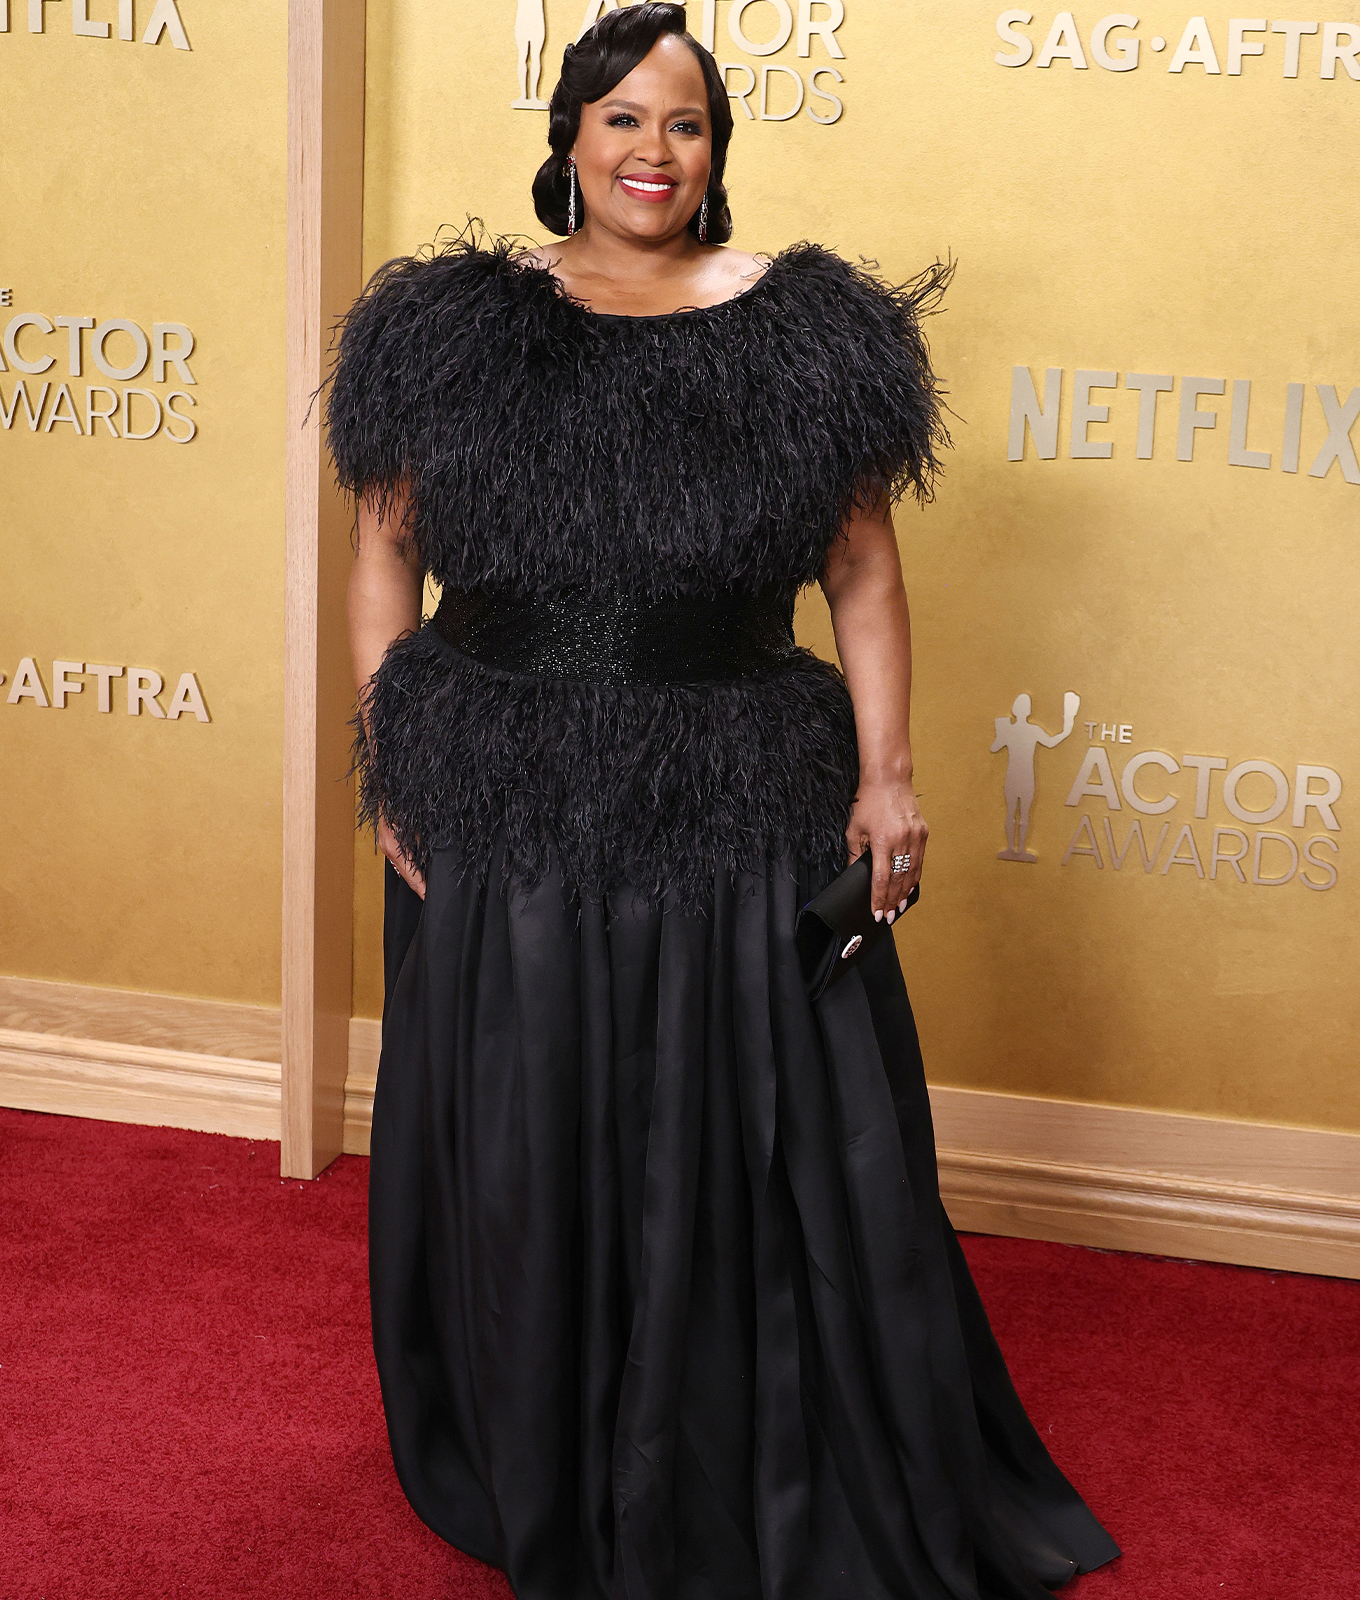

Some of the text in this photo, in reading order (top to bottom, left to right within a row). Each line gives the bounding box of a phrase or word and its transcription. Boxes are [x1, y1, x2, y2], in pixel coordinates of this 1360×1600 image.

[0, 313, 196, 384] CTOR
[1007, 366, 1360, 485] NETFLIX
[1085, 722, 1133, 743] THE
[1065, 746, 1342, 830] ACTOR
[1061, 815, 1339, 891] AWARDS
